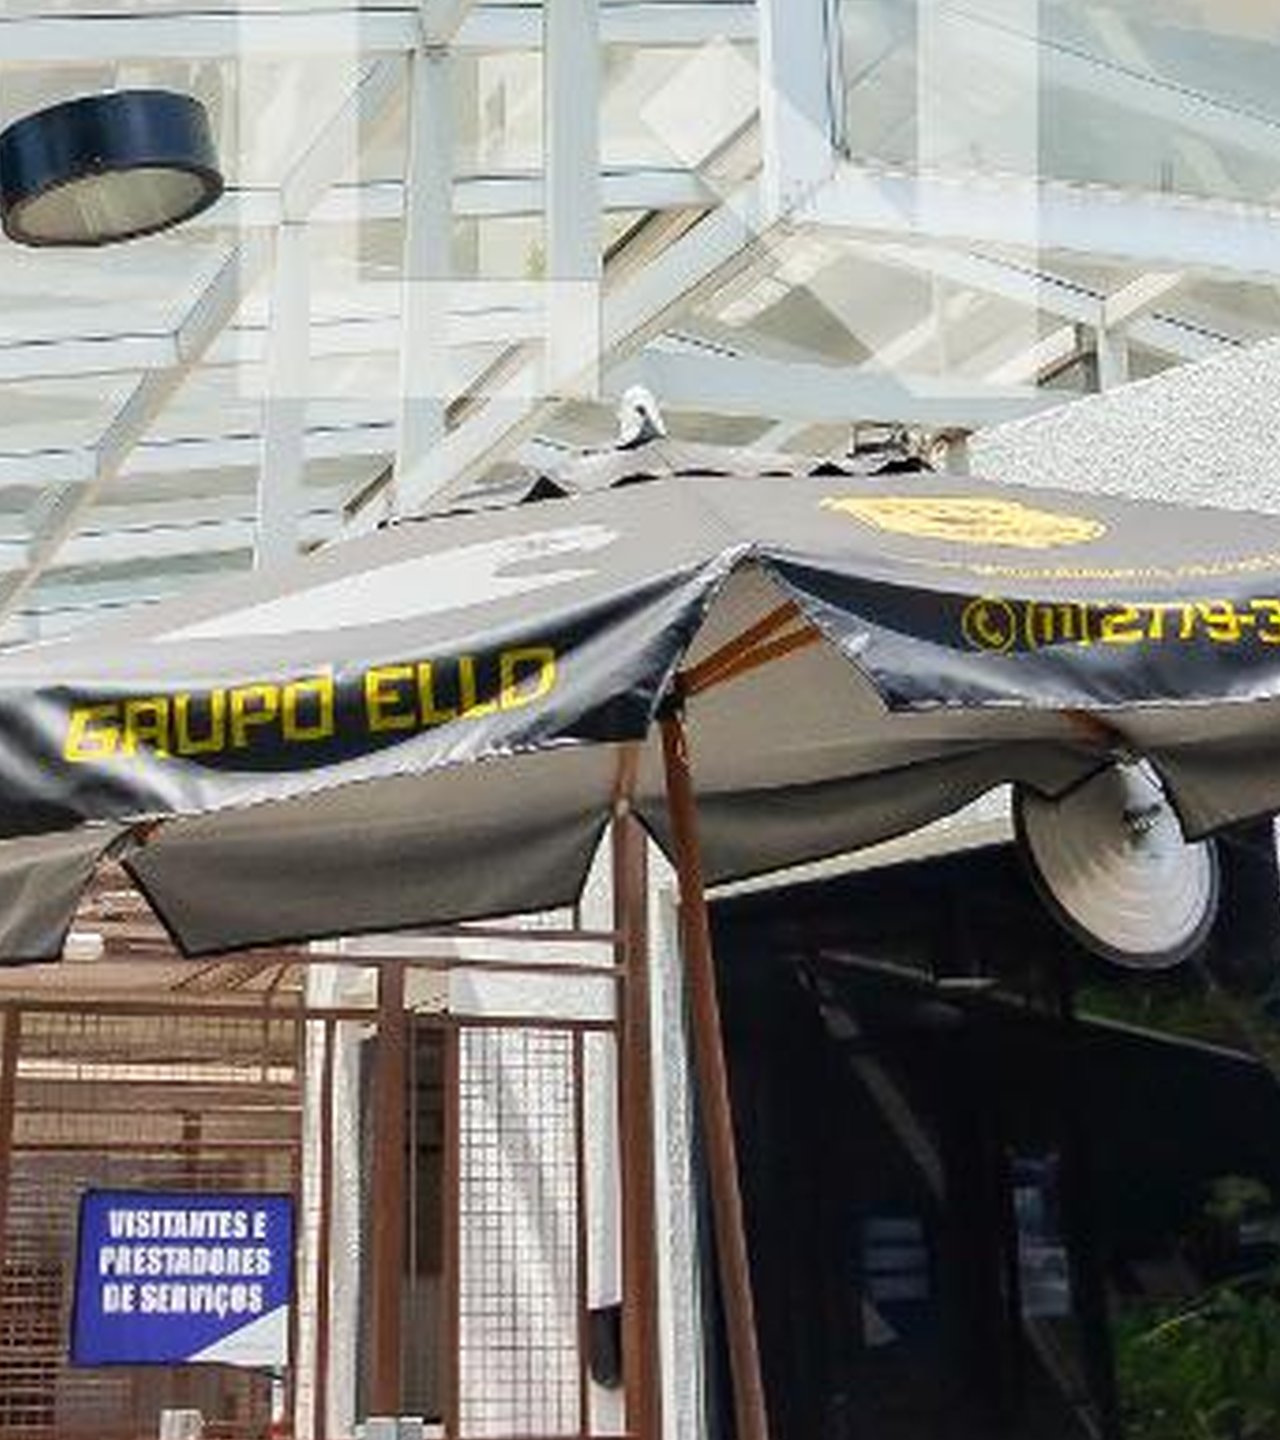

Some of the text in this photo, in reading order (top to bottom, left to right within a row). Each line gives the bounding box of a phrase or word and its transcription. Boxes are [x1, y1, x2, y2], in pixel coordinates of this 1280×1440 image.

[62, 646, 557, 764] GRUPO ELLO
[108, 1209, 267, 1239] VISITANTES E
[99, 1245, 272, 1276] PRESTADORES
[102, 1282, 264, 1320] DE SERVIÇOS
